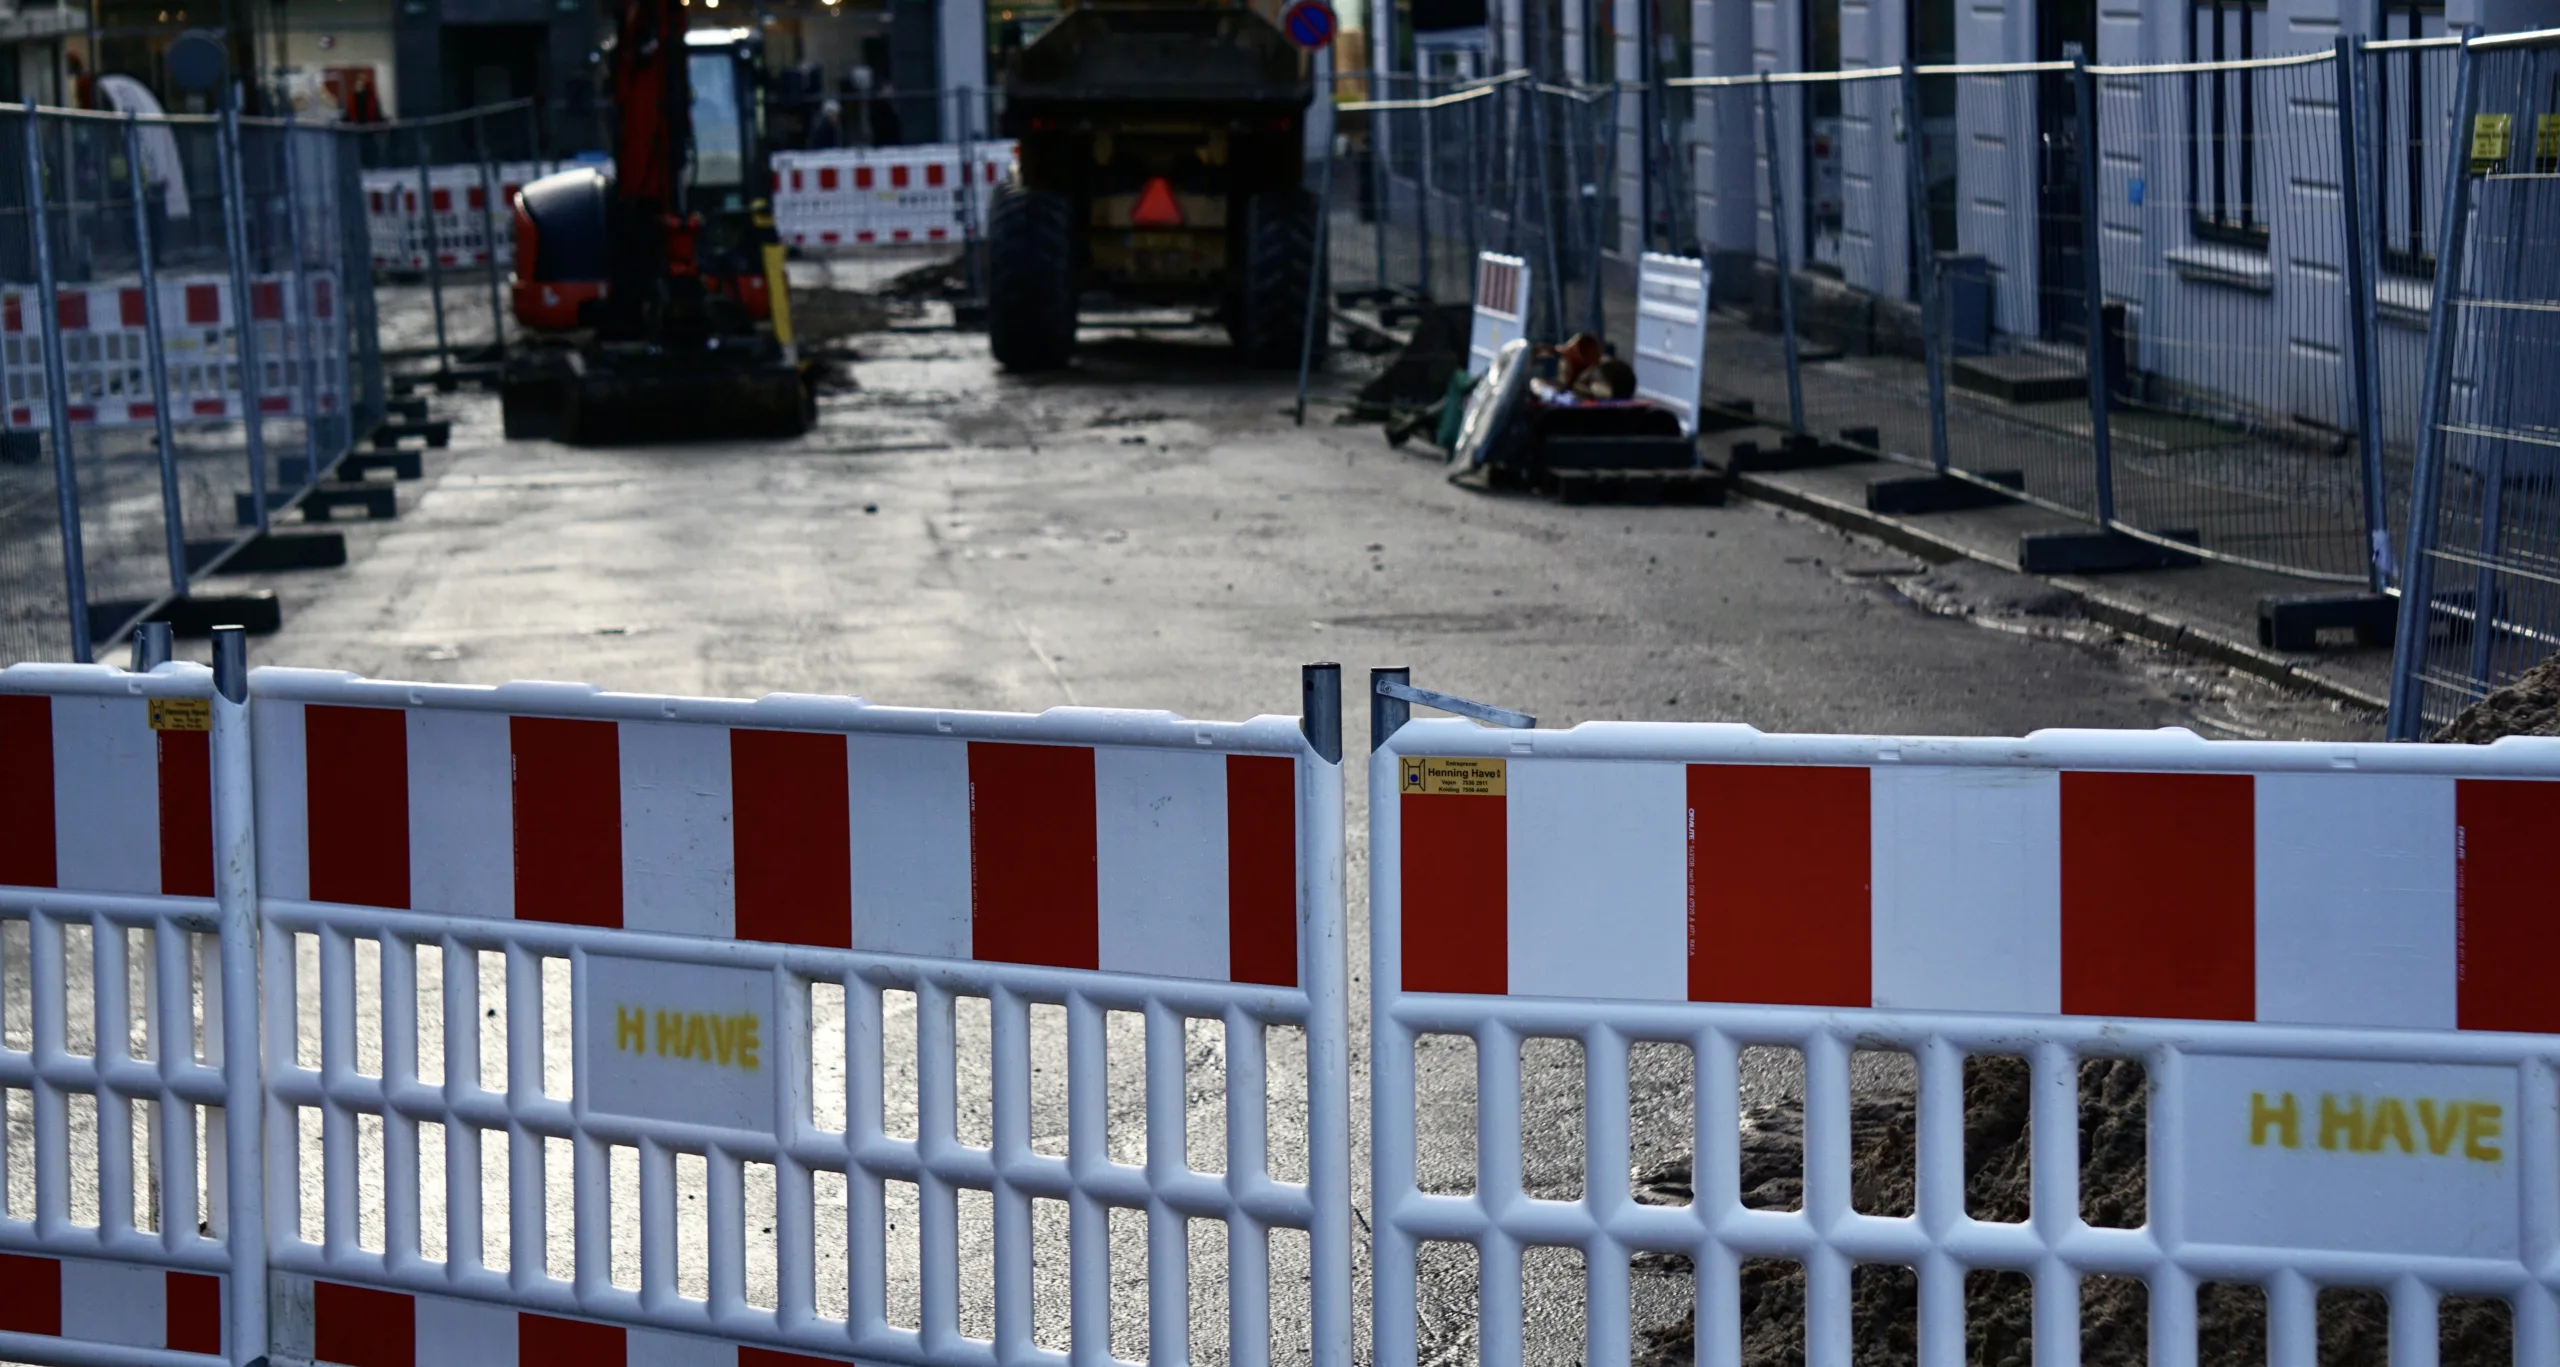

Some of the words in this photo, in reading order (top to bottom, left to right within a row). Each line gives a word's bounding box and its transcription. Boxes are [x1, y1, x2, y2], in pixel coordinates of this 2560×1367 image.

[1428, 767, 1469, 779] Henning
[1471, 768, 1496, 778] Have
[617, 1004, 645, 1055] H
[656, 1009, 760, 1071] HAVE
[2251, 1091, 2299, 1148] H
[2319, 1092, 2502, 1161] HAVE
